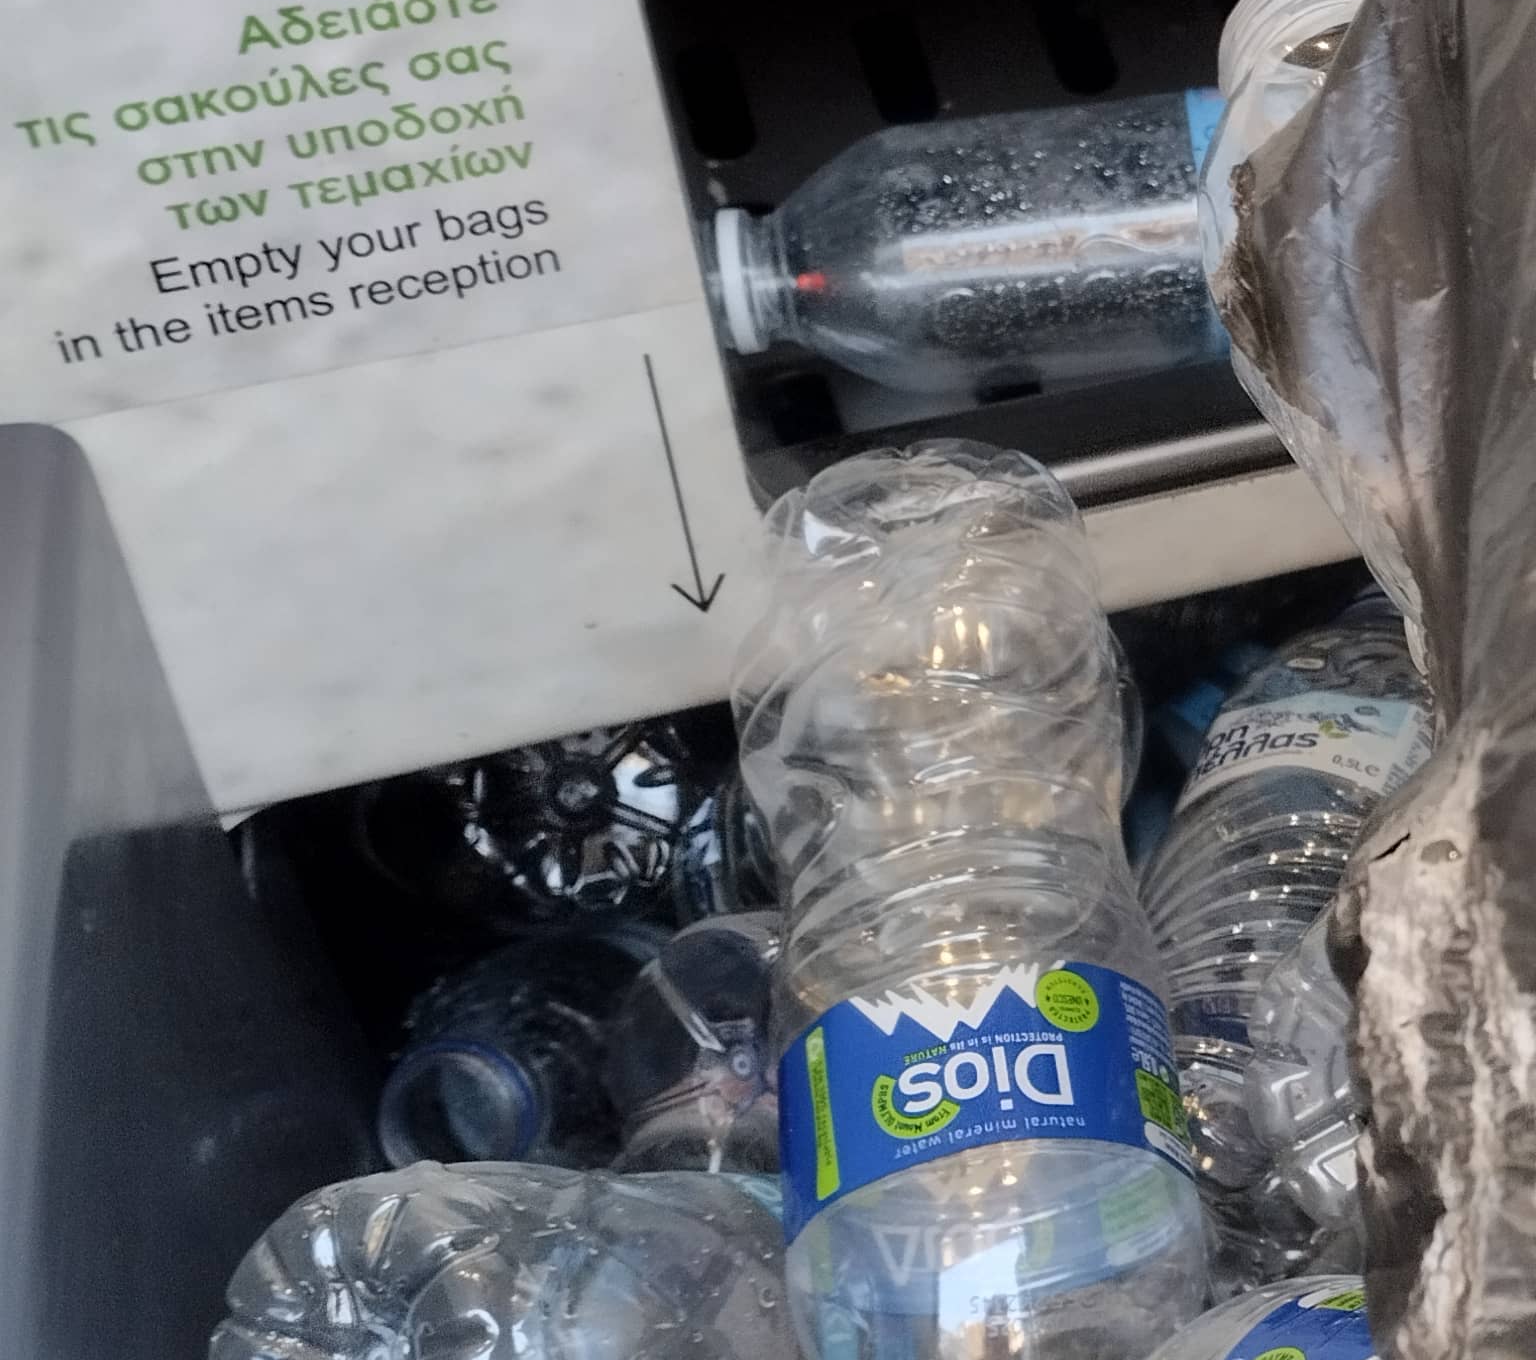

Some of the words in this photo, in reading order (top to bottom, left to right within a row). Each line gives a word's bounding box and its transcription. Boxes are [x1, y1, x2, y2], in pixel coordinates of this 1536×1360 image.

[14, 111, 97, 148] τις
[113, 61, 391, 132] σακούλες
[408, 40, 512, 82] σας
[136, 138, 264, 185] στην
[286, 84, 525, 160] υποδοχή
[164, 189, 268, 231] των
[287, 141, 533, 208] τεμαχίων
[149, 242, 302, 295] Empty
[318, 222, 421, 273] your
[435, 199, 549, 241] bags
[57, 329, 102, 364] in
[115, 318, 192, 353] the
[203, 291, 335, 336] items
[349, 247, 561, 309] reception
[903, 1044, 948, 1064] NATURE
[994, 1032, 1064, 1044] PROTECTION
[898, 1043, 1075, 1113] Dios
[894, 1135, 942, 1160] water
[949, 1118, 1017, 1139] mineral
[1024, 1116, 1086, 1128] natural
